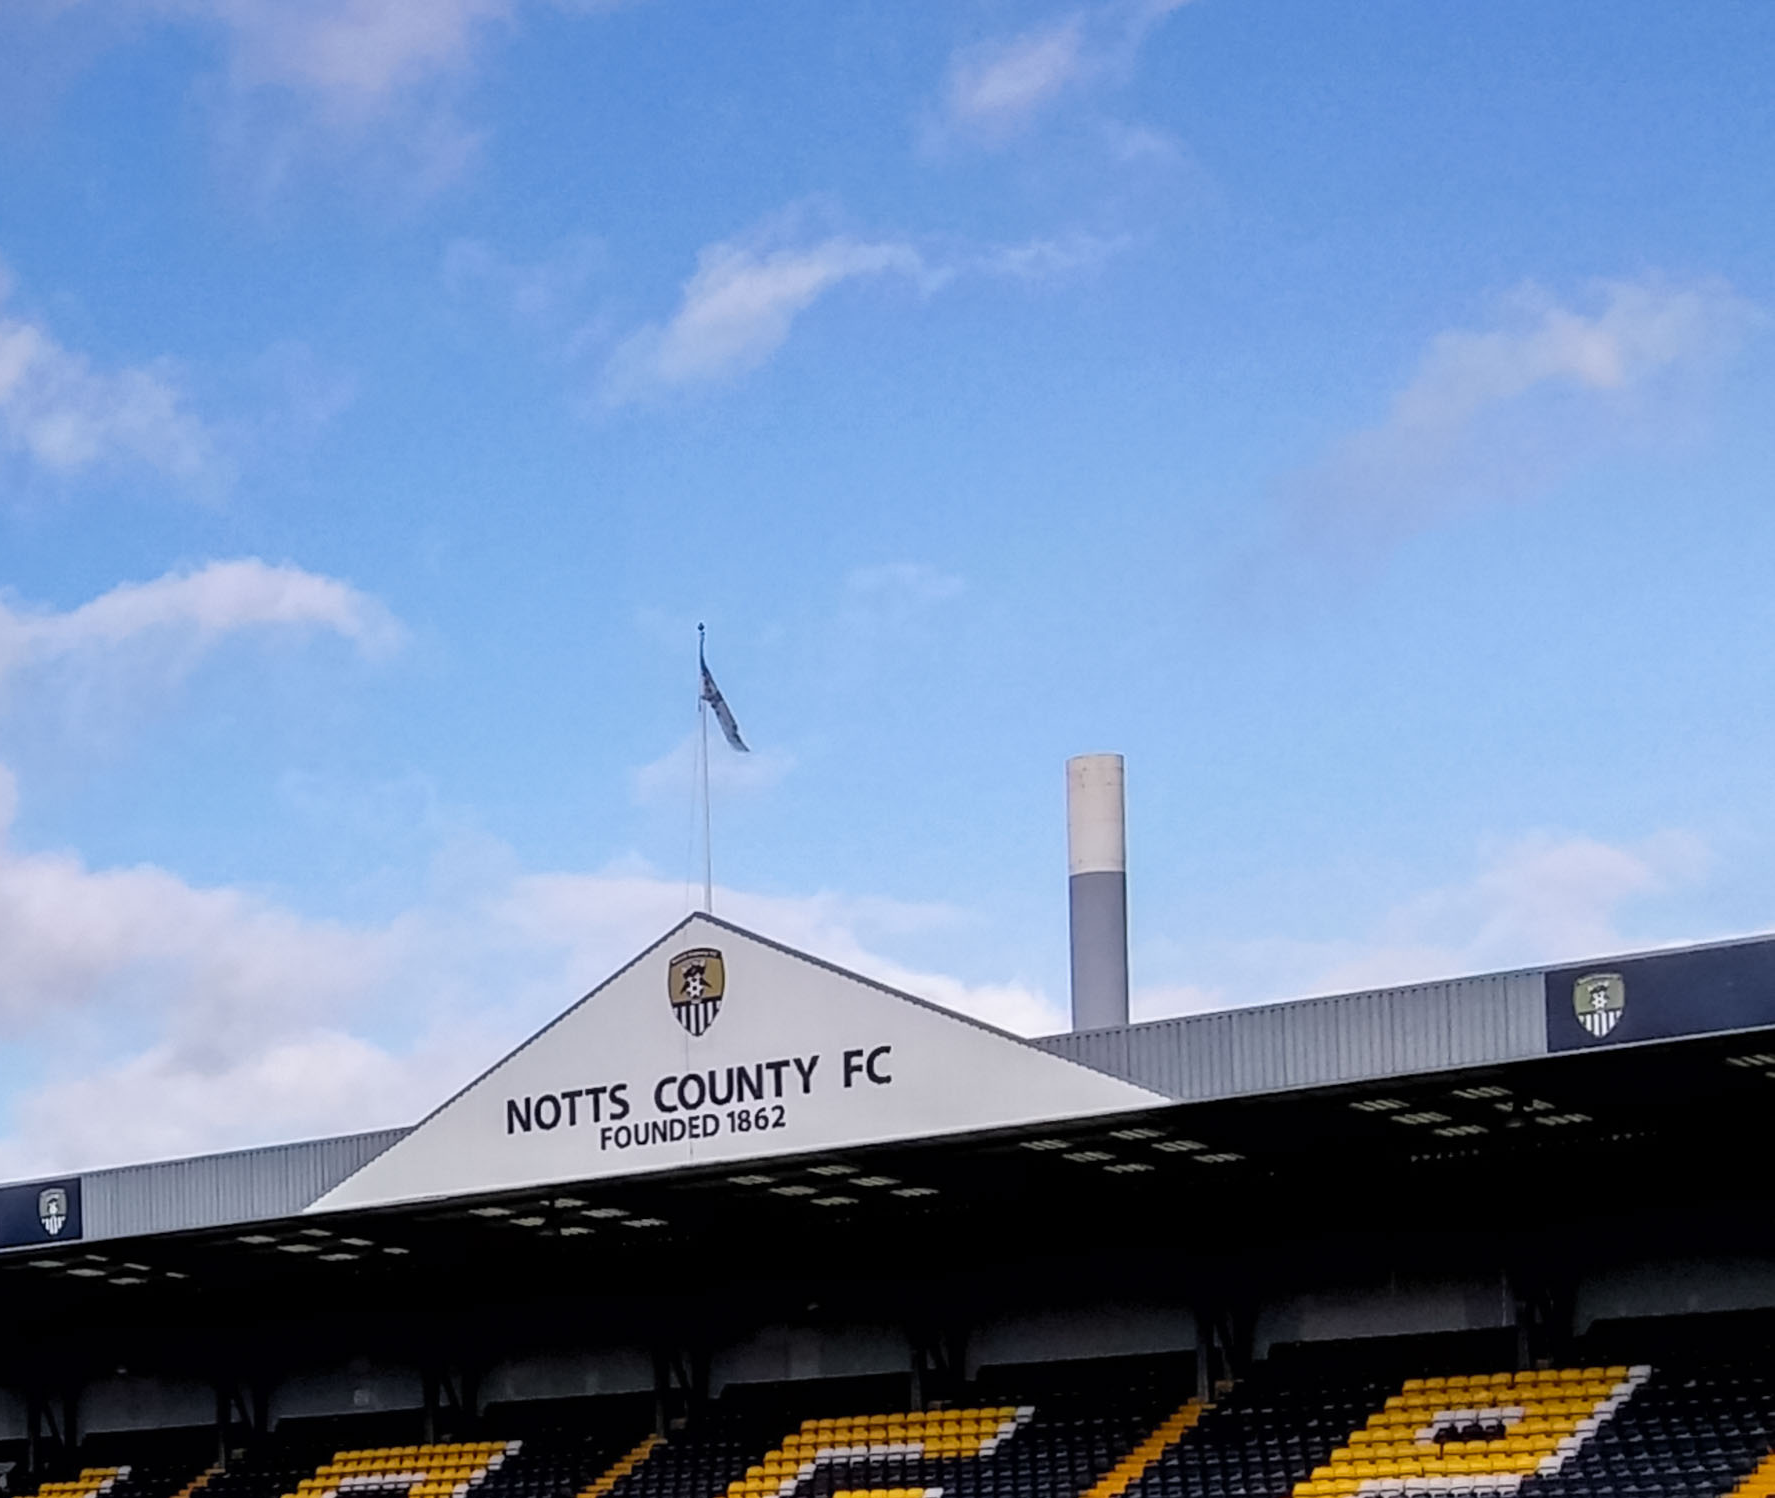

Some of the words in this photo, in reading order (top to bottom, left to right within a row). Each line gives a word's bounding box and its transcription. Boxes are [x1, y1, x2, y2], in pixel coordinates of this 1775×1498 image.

[506, 1084, 630, 1135] NOTTS
[653, 1055, 820, 1114] COUNTY
[843, 1045, 893, 1089] FC
[600, 1113, 721, 1152] FOUNDED
[728, 1104, 787, 1135] 1862
